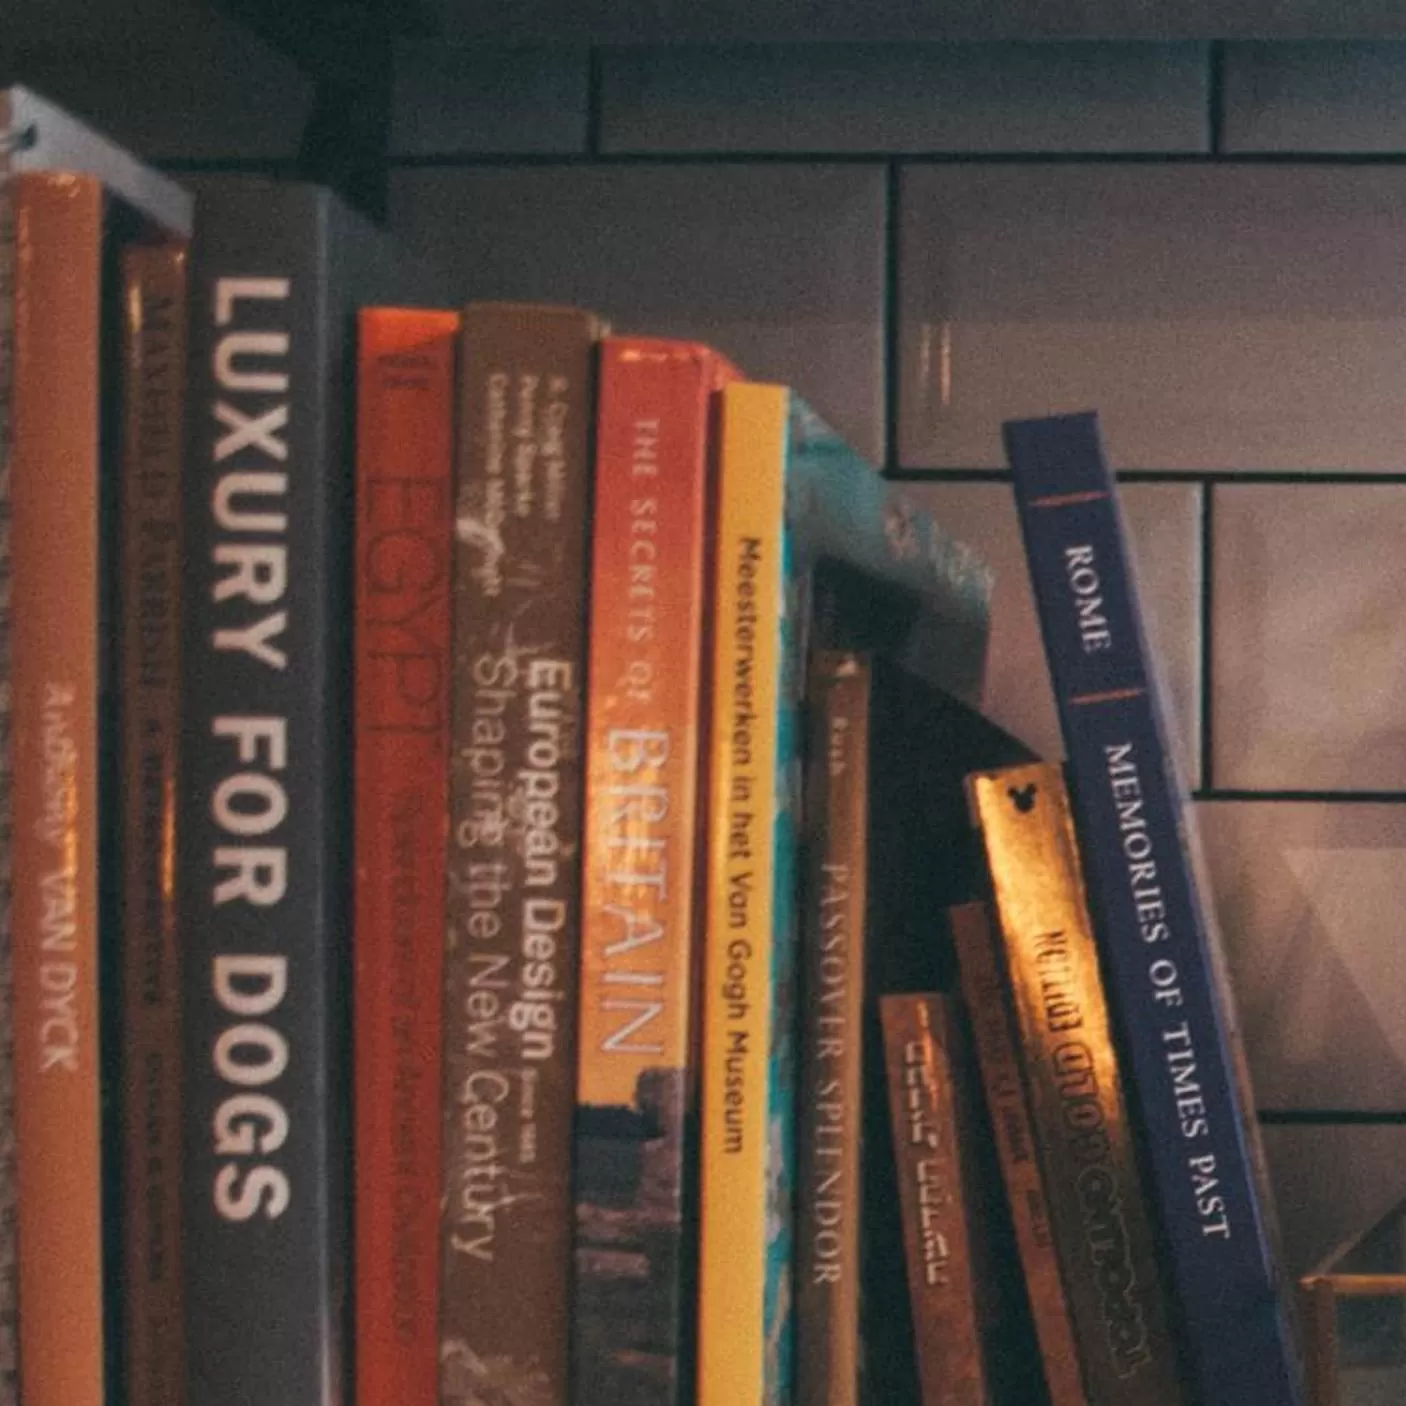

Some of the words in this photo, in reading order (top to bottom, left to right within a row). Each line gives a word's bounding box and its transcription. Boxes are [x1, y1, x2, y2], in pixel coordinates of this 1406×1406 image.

[211, 276, 290, 670] LUXURY
[630, 417, 661, 478] THE
[366, 474, 443, 737] EGYPT
[626, 498, 660, 643] SECRETS
[1064, 543, 1112, 654] ROME
[623, 658, 655, 704] OF
[732, 535, 764, 770] Meesterwerken
[460, 651, 517, 847] Shaping
[518, 658, 572, 885] European
[732, 775, 758, 804] in
[211, 714, 290, 907] FOR
[729, 811, 760, 859] het
[1104, 741, 1170, 943] MEMORIES
[40, 870, 77, 951] VAN
[466, 859, 511, 939] the
[600, 726, 671, 1054] BRITAIN
[728, 871, 756, 932] Van
[38, 960, 78, 1073] DYCK
[466, 955, 510, 1058] New
[510, 898, 566, 1060] Design
[717, 939, 755, 1021] Gogh
[815, 862, 850, 1060] PASSOVER
[1034, 930, 1084, 1033] EDITION
[1149, 958, 1183, 1008] OF
[211, 952, 291, 1223] DOGS
[724, 1030, 752, 1154] Museum
[1160, 1020, 1209, 1139] TIMES
[450, 1069, 511, 1262] Century
[811, 1079, 847, 1287] SPLENDOR
[1186, 1152, 1232, 1240] PAST
